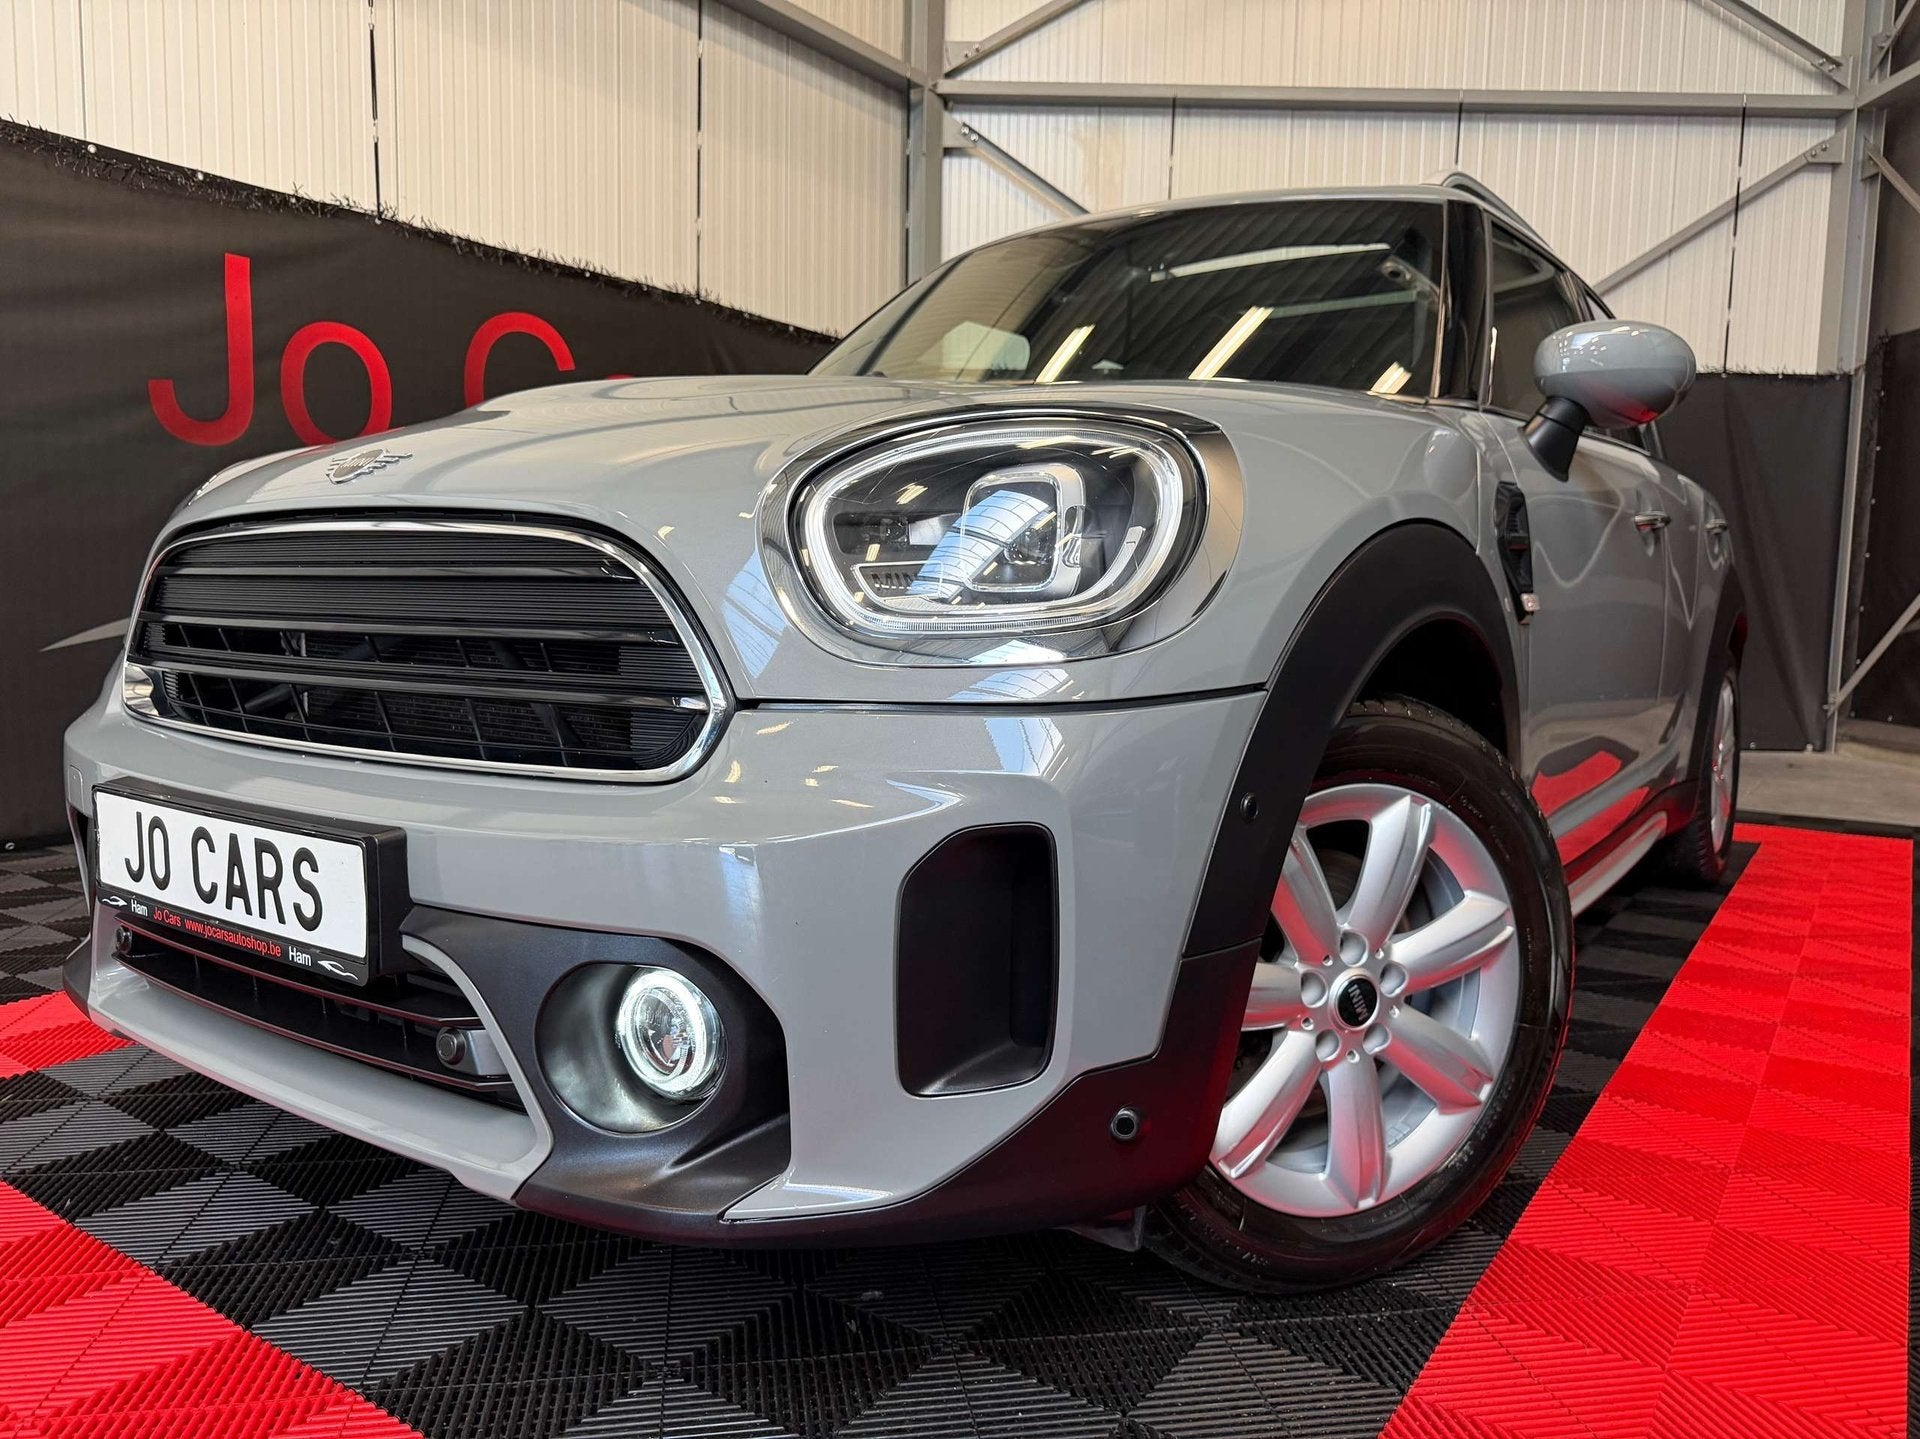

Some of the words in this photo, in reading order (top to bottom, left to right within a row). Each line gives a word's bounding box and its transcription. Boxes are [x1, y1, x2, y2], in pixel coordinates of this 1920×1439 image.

[148, 252, 393, 447] Jo
[124, 811, 171, 891] JO
[191, 826, 323, 932] CARS
[130, 898, 148, 917] Ham
[153, 906, 162, 921] Jo
[163, 909, 181, 927] Cars
[185, 918, 281, 957] www.jocarsautoshop.be
[288, 945, 311, 967] Ham
[1347, 983, 1369, 1021] MINI
